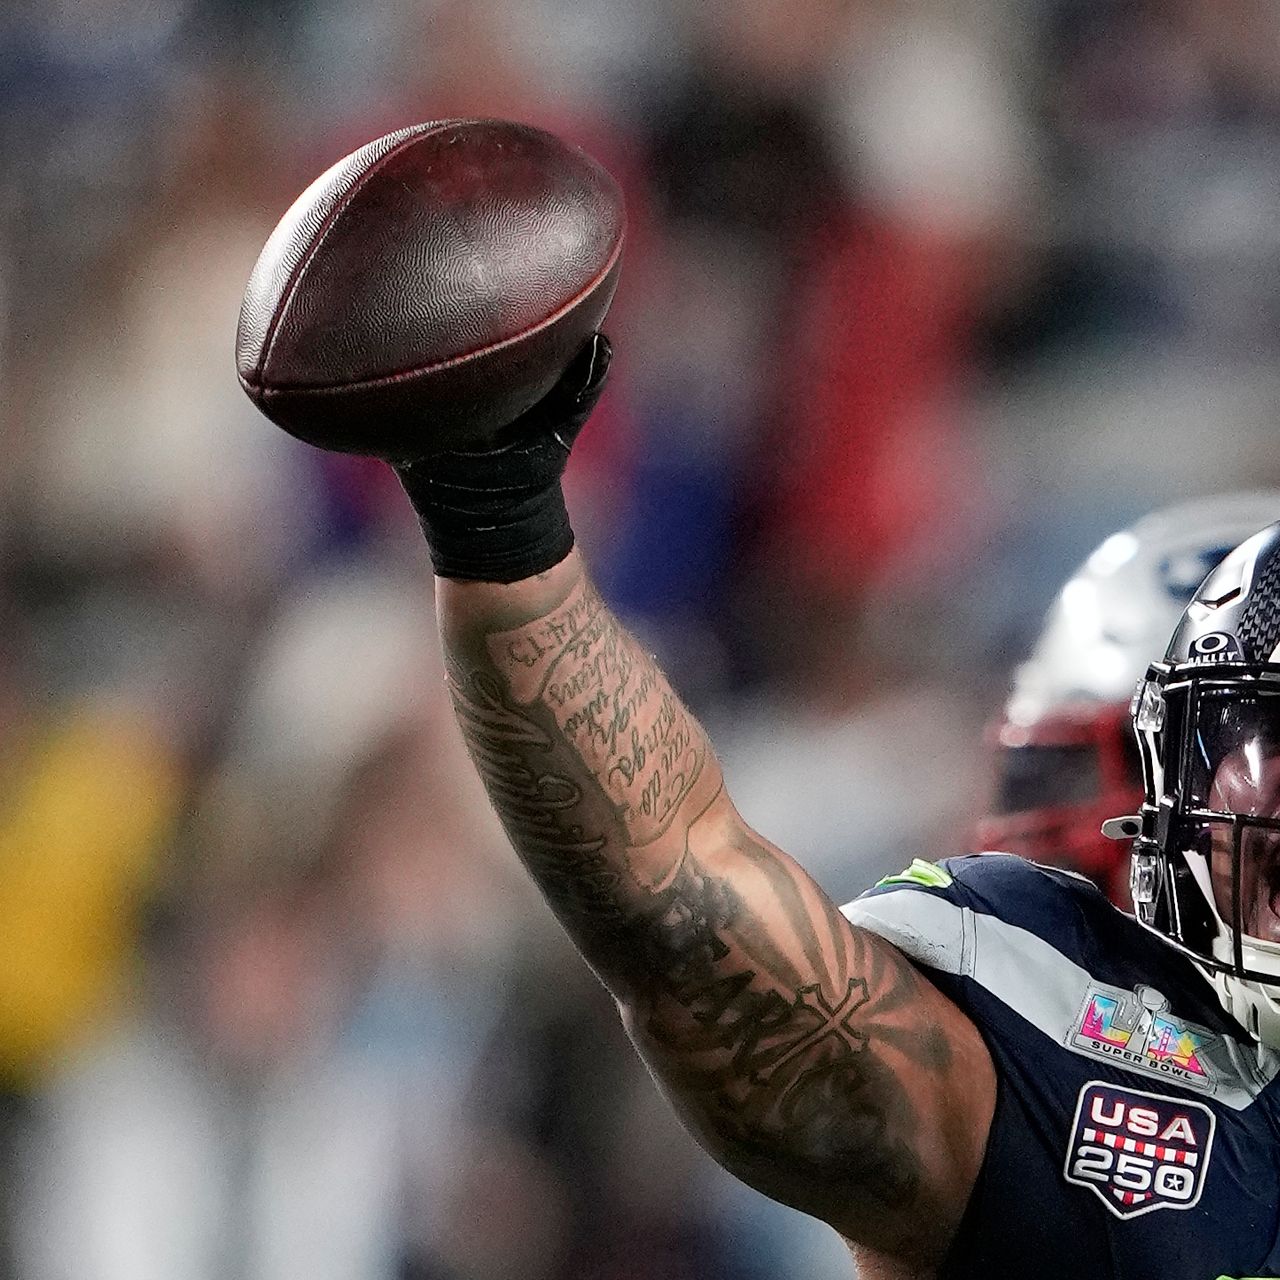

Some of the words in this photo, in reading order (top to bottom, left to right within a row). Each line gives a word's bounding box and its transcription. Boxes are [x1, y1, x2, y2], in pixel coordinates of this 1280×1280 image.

[1187, 650, 1238, 665] OAKLEY
[1091, 1040, 1142, 1065] SUPER
[1149, 1060, 1193, 1080] BOWL
[1091, 1096, 1198, 1146] USA
[1072, 1145, 1195, 1200] 250
